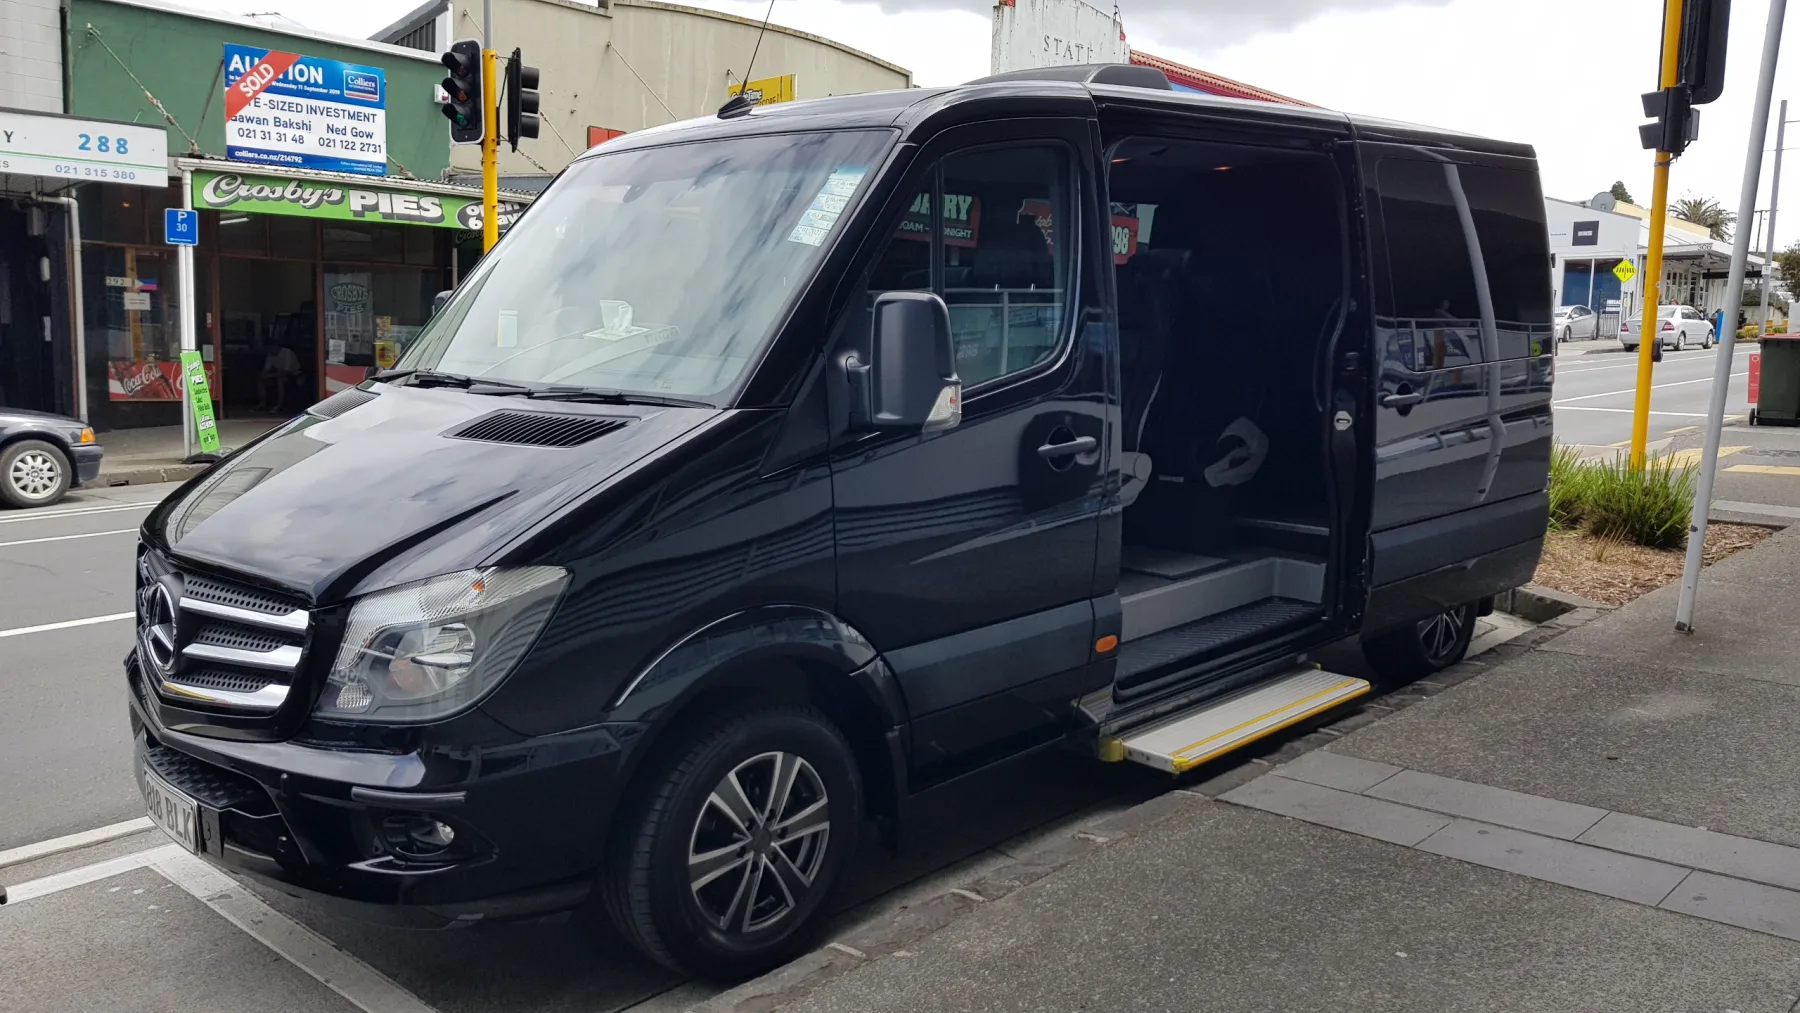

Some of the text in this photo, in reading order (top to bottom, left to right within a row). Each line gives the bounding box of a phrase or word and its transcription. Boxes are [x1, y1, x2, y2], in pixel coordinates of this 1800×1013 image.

[229, 54, 323, 84] AUION
[239, 63, 275, 98] SOLD
[271, 81, 298, 90] Wednesday
[304, 85, 328, 93] September
[347, 75, 376, 88] Colliers
[248, 97, 377, 124] E-SIZED INVESTMENT
[273, 115, 312, 132] Bakshi
[326, 123, 374, 140] Ned Gow
[3, 130, 129, 155] Y 288
[237, 127, 305, 145] 021 31 31 48
[318, 137, 382, 154] 021 122 2731
[234, 149, 304, 164] colliers.co.nz/214792
[55, 164, 79, 175] 021
[84, 167, 108, 178] 315
[113, 169, 136, 181] 380
[202, 173, 445, 224] Crosby's PIES
[177, 211, 188, 222] P
[469, 216, 484, 230] 6
[176, 222, 188, 232] 30
[107, 277, 125, 286] 292
[335, 302, 364, 314] PIES
[123, 363, 163, 396] Coca-Cola
[146, 779, 193, 846] 818 BLK
